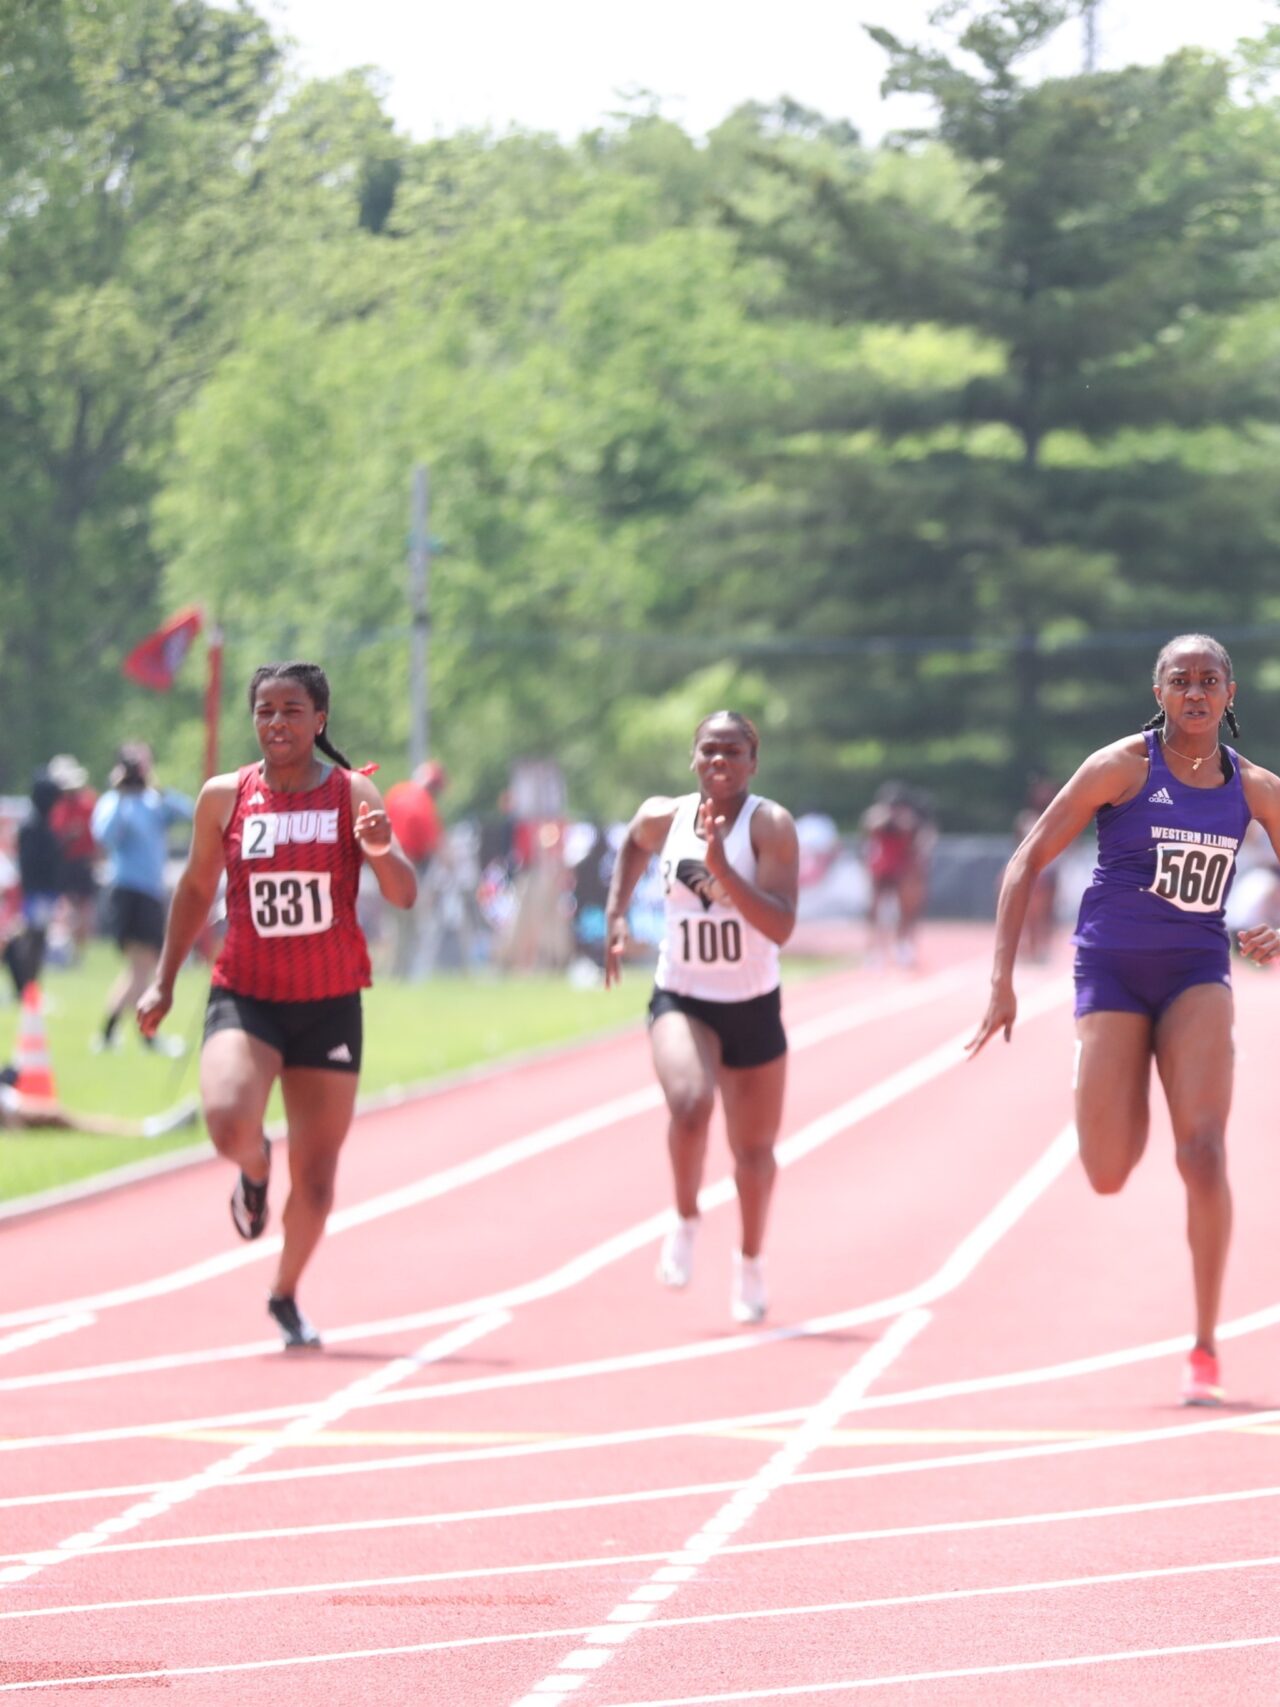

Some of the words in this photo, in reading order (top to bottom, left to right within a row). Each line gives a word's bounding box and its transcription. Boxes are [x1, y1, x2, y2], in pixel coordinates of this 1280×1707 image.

[249, 820, 267, 854] 2
[275, 808, 339, 845] IUE
[1151, 826, 1201, 843] WESTERN
[1155, 849, 1228, 905] 560
[254, 878, 322, 928] 331
[679, 918, 742, 963] 100
